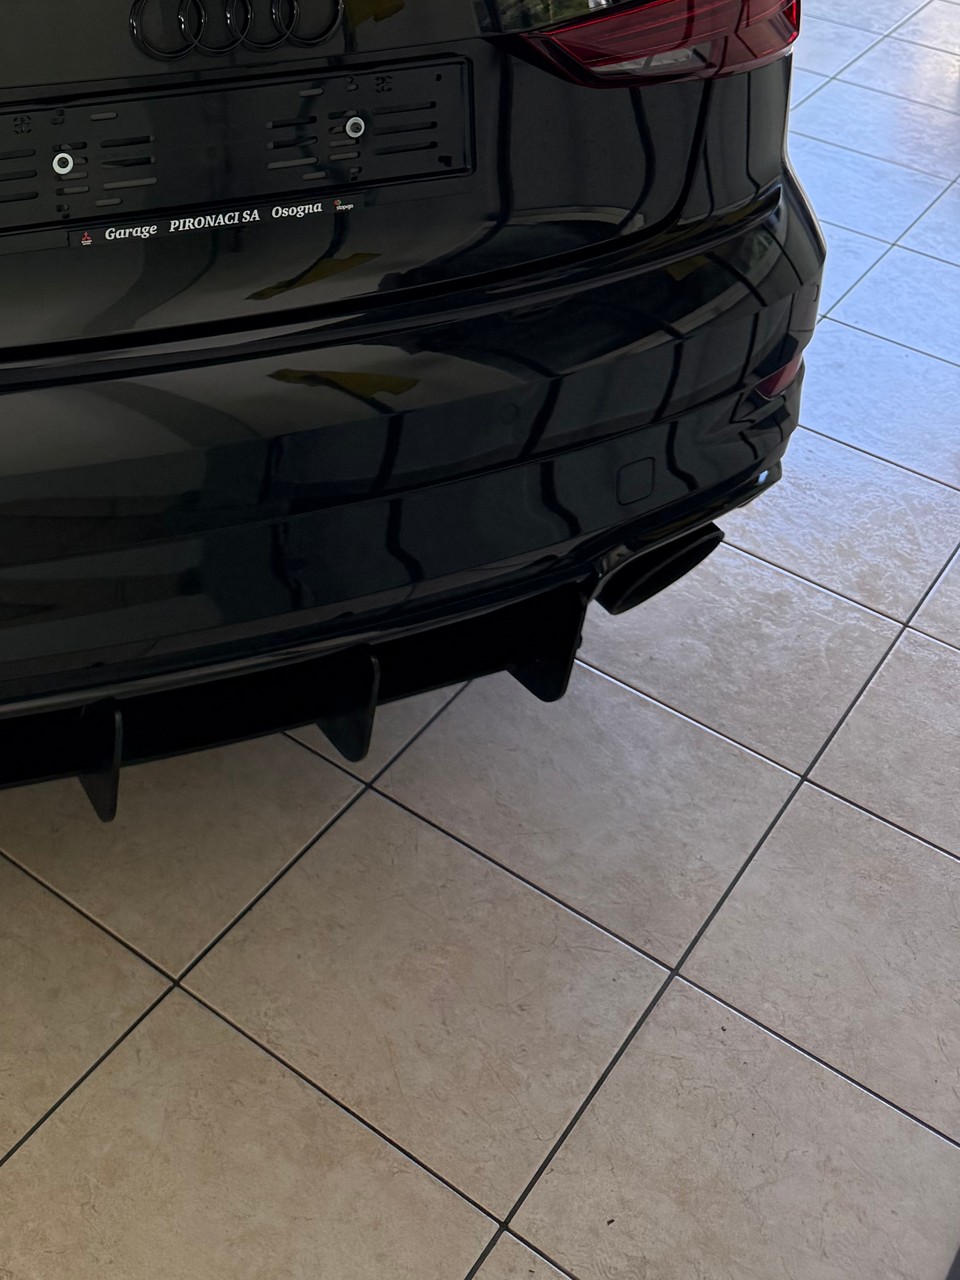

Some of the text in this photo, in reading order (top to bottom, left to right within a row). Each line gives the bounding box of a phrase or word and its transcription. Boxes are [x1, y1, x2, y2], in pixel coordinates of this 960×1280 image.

[104, 202, 323, 240] Garage PIRONACI SA Osogna
